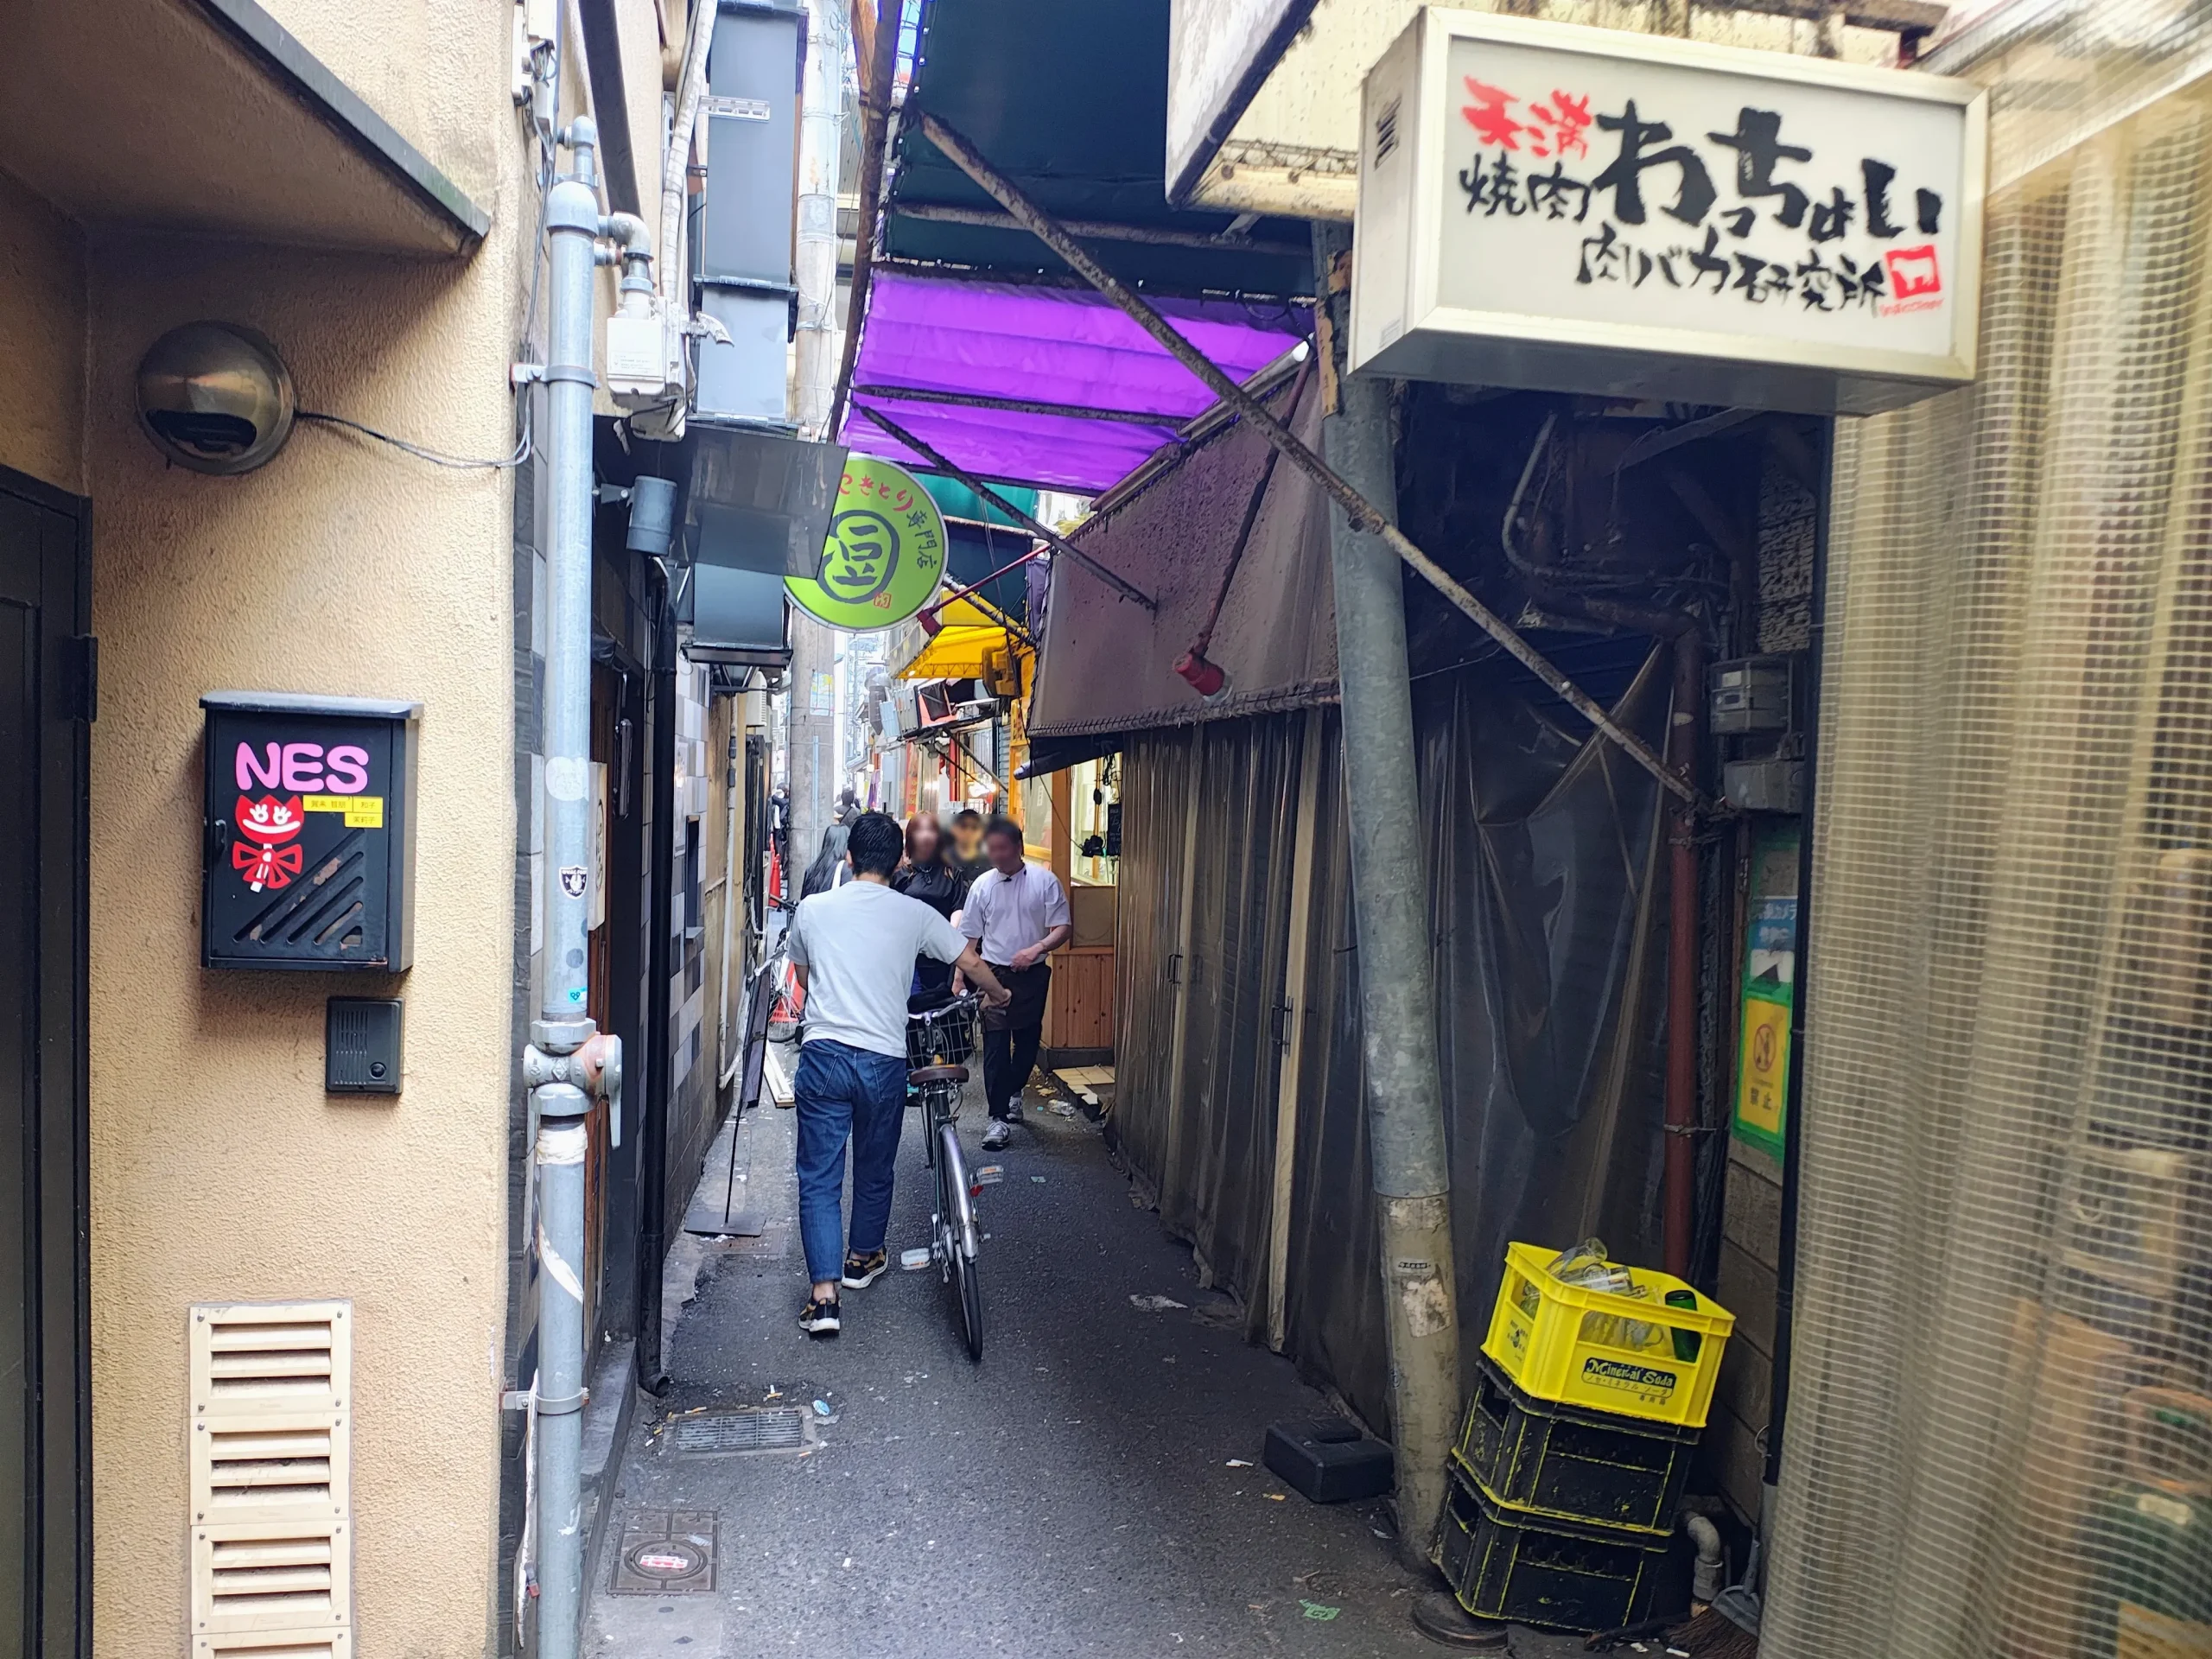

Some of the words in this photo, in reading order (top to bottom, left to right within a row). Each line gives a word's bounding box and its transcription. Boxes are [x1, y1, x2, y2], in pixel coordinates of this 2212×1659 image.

[1463, 75, 1593, 160] 天満
[1459, 151, 1595, 222] 焼肉
[1590, 99, 1942, 242] わっちょい
[1576, 225, 1887, 317] 肉バカ研究所
[235, 741, 370, 794] NES
[1586, 1358, 1641, 1381] Mineral
[1643, 1370, 1674, 1387] Soda
